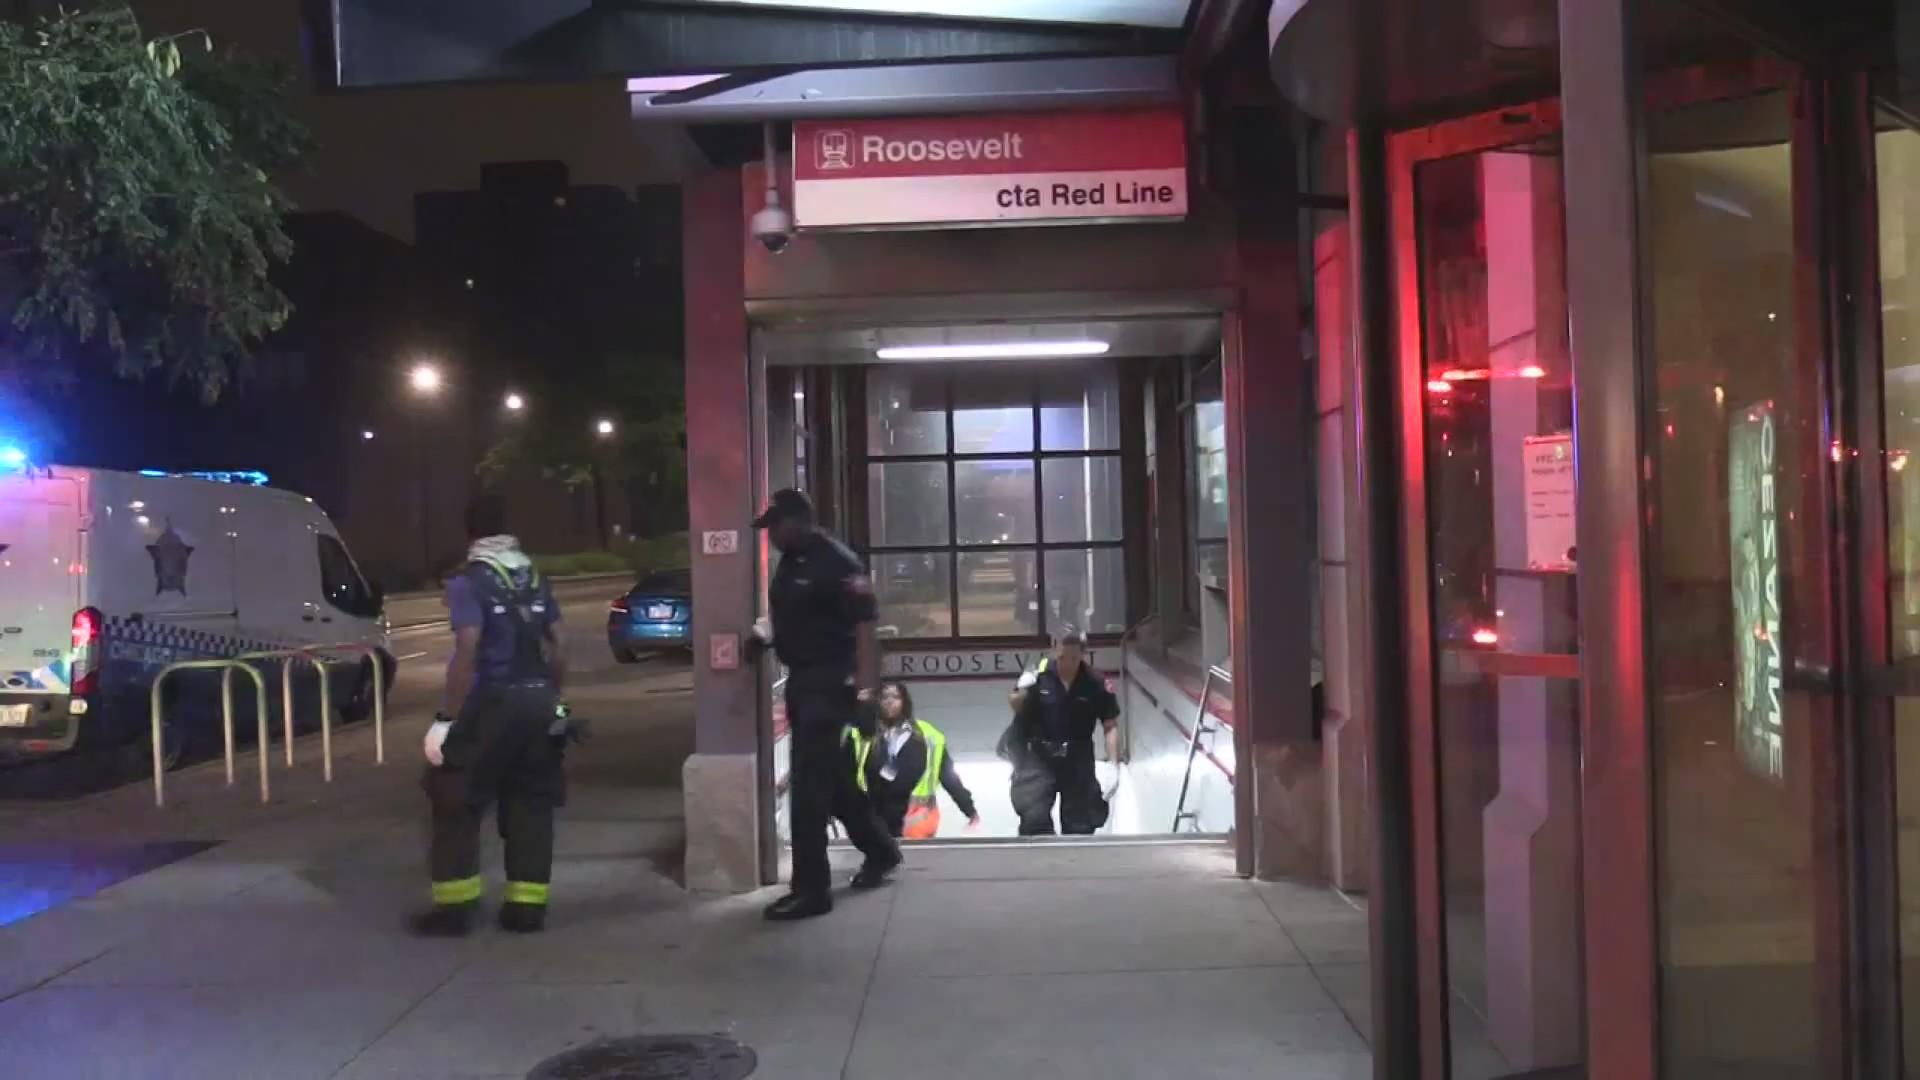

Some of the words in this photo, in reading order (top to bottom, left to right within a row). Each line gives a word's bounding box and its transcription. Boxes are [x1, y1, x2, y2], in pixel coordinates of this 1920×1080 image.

[861, 132, 1023, 163] Roosevelt
[996, 185, 1041, 208] cta
[1051, 182, 1105, 206] Red
[1114, 181, 1174, 205] Line
[901, 651, 1097, 674] ROOSEVT
